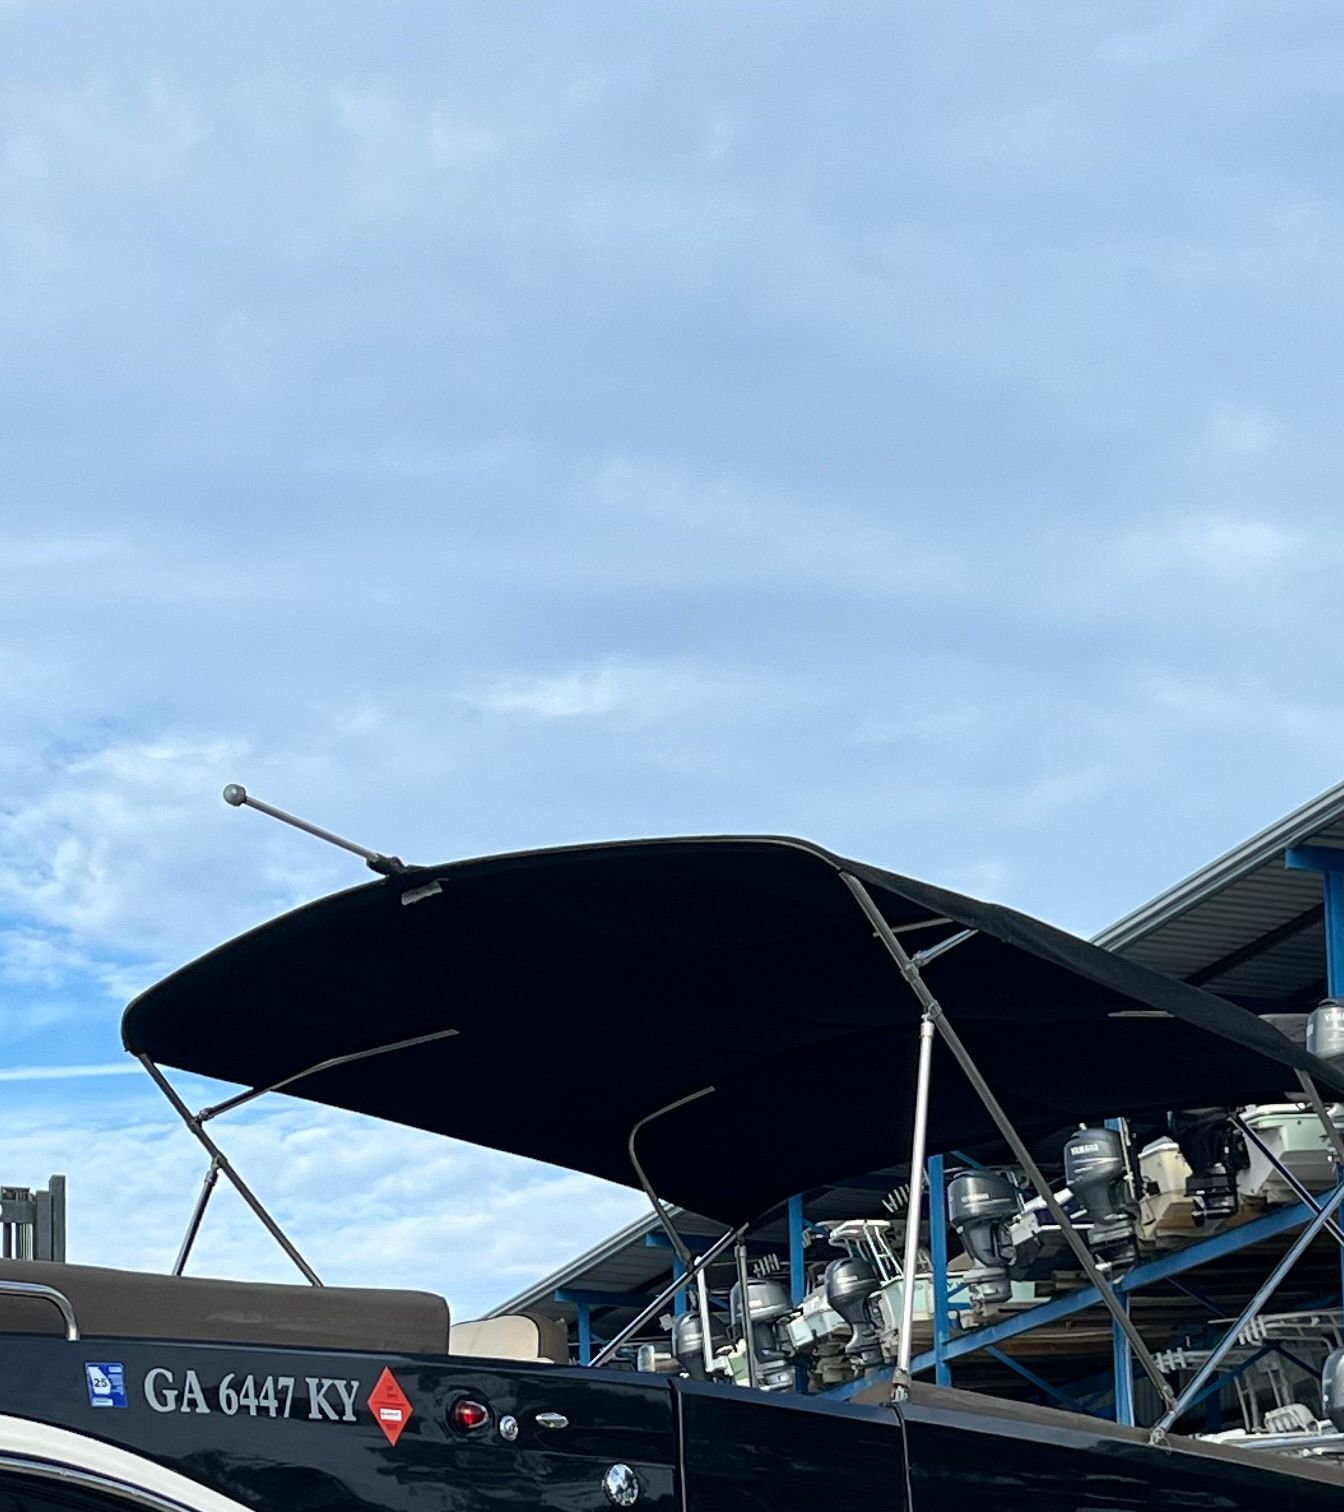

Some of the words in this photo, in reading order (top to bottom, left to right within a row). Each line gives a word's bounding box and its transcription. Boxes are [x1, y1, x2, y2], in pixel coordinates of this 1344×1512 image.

[143, 1367, 211, 1414] GA
[219, 1373, 295, 1418] 6447
[305, 1376, 360, 1422] KY
